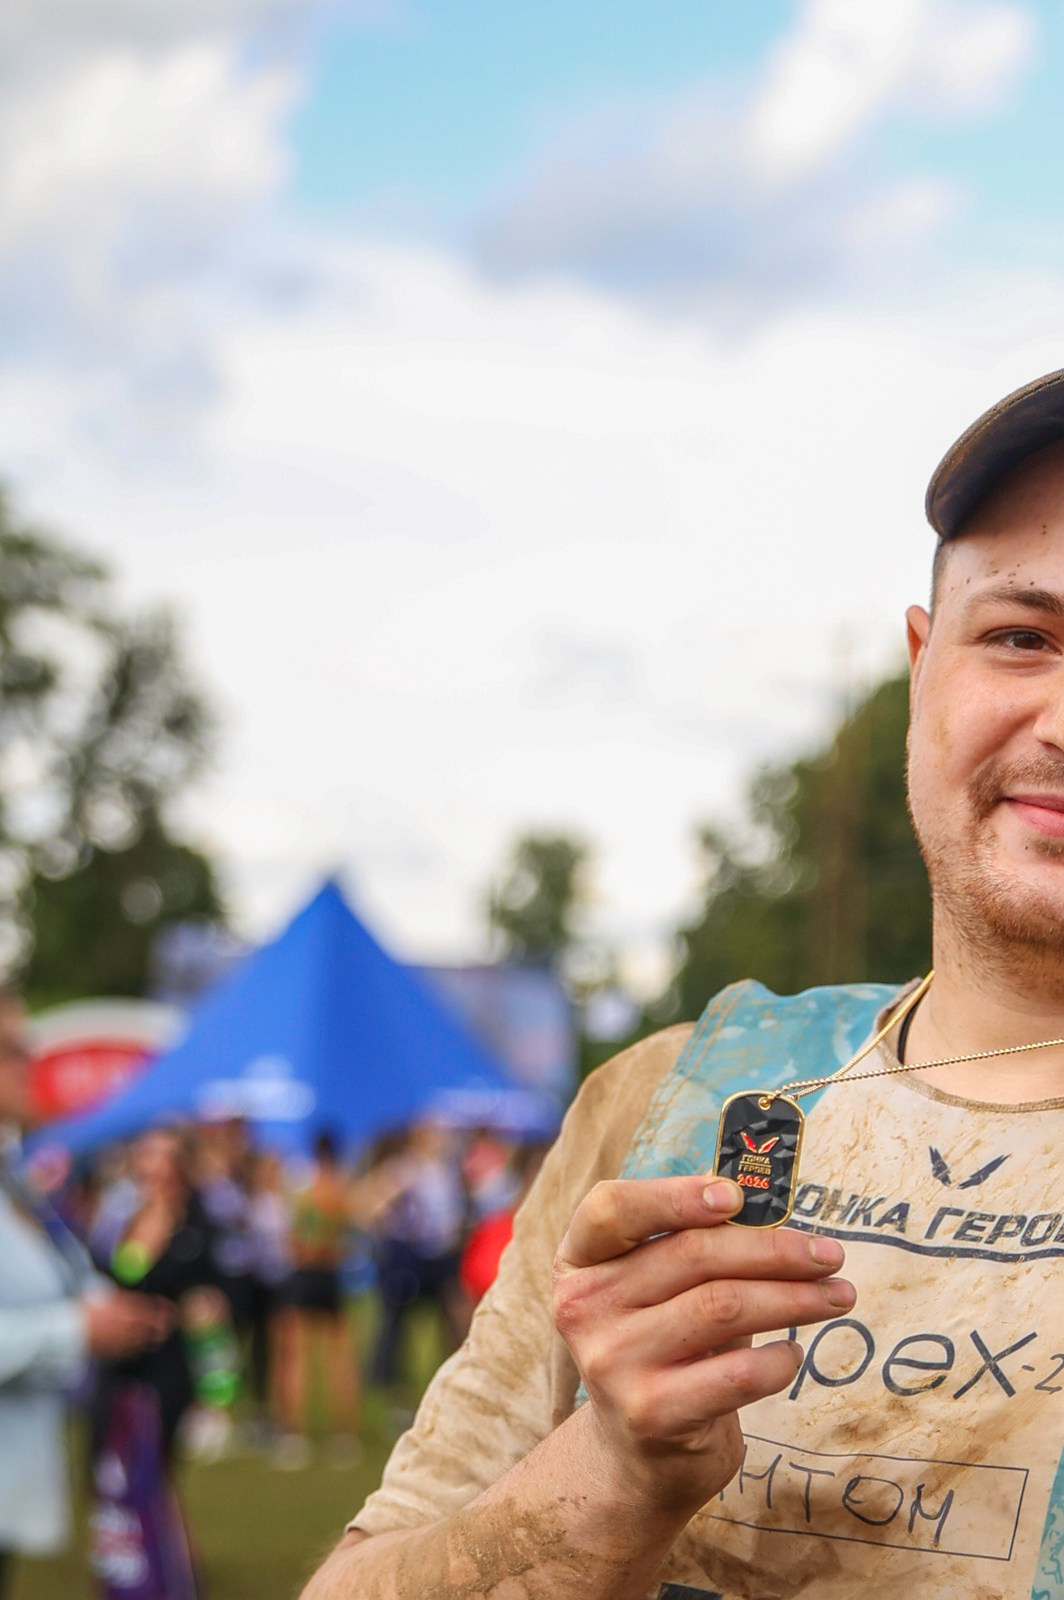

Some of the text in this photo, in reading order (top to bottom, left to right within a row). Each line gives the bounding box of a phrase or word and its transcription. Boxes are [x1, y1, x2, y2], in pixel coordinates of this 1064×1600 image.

[736, 1174, 771, 1190] 2026
[792, 1182, 911, 1233] ОНКА
[719, 1443, 955, 1547] НТОМ
